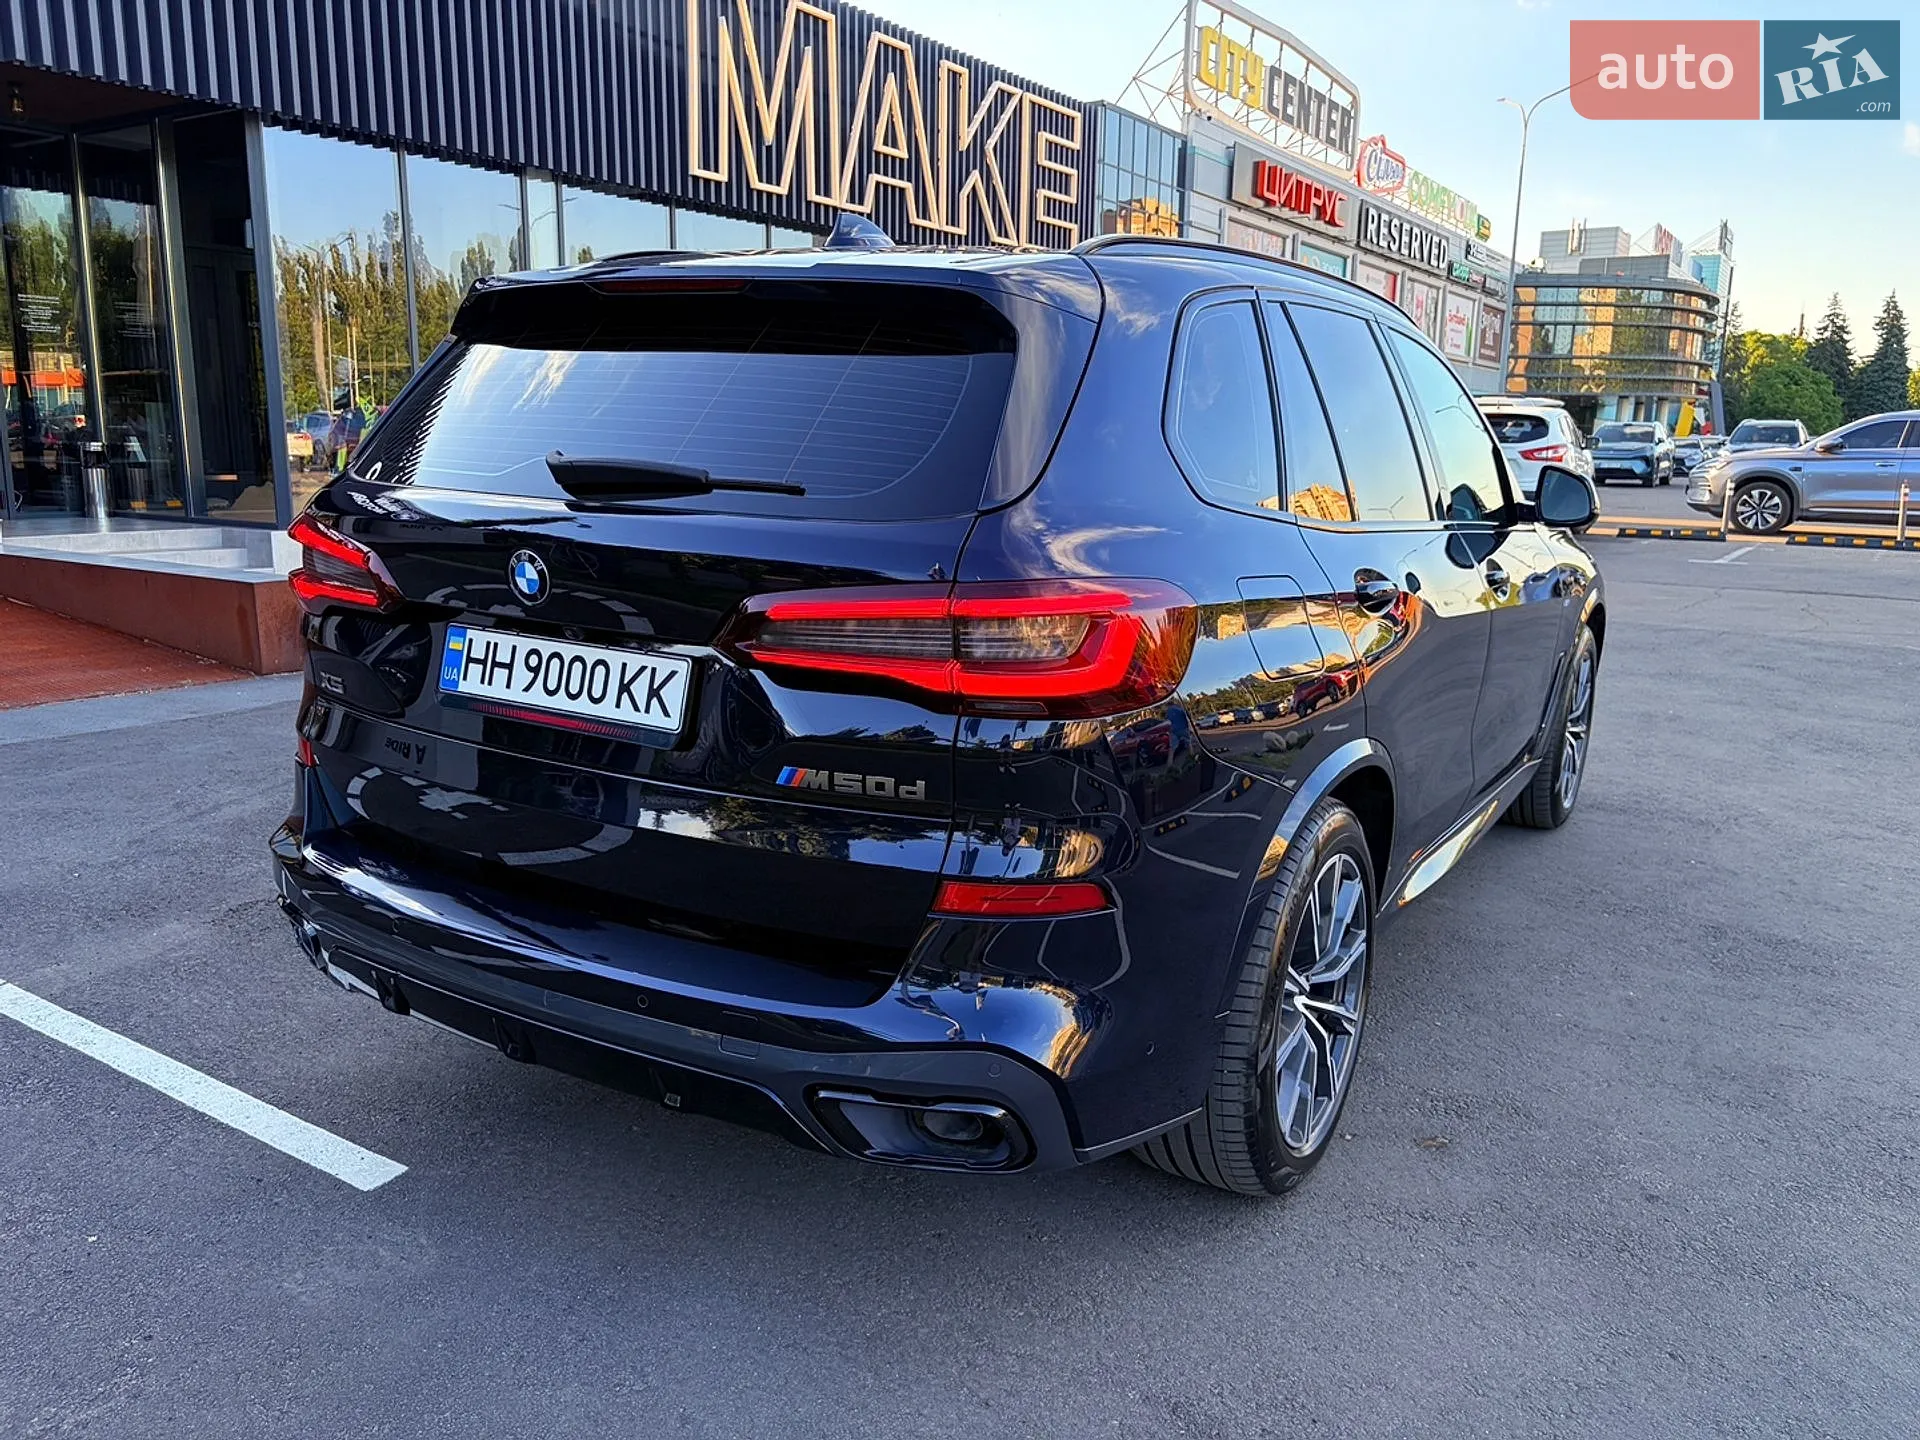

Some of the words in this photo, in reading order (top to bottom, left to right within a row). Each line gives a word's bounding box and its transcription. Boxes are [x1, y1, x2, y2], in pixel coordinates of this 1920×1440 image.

[1197, 25, 1264, 111] CITY
[1264, 65, 1352, 158] CENTER
[687, 0, 1082, 250] MAKE
[1255, 160, 1348, 228] ЦИТРУС
[1366, 206, 1448, 269] RESERVED
[320, 671, 345, 695] X5
[443, 666, 459, 681] UA
[462, 637, 517, 690] HH
[521, 647, 611, 705] 9000
[614, 661, 680, 719] KK
[799, 768, 926, 801] M50d
